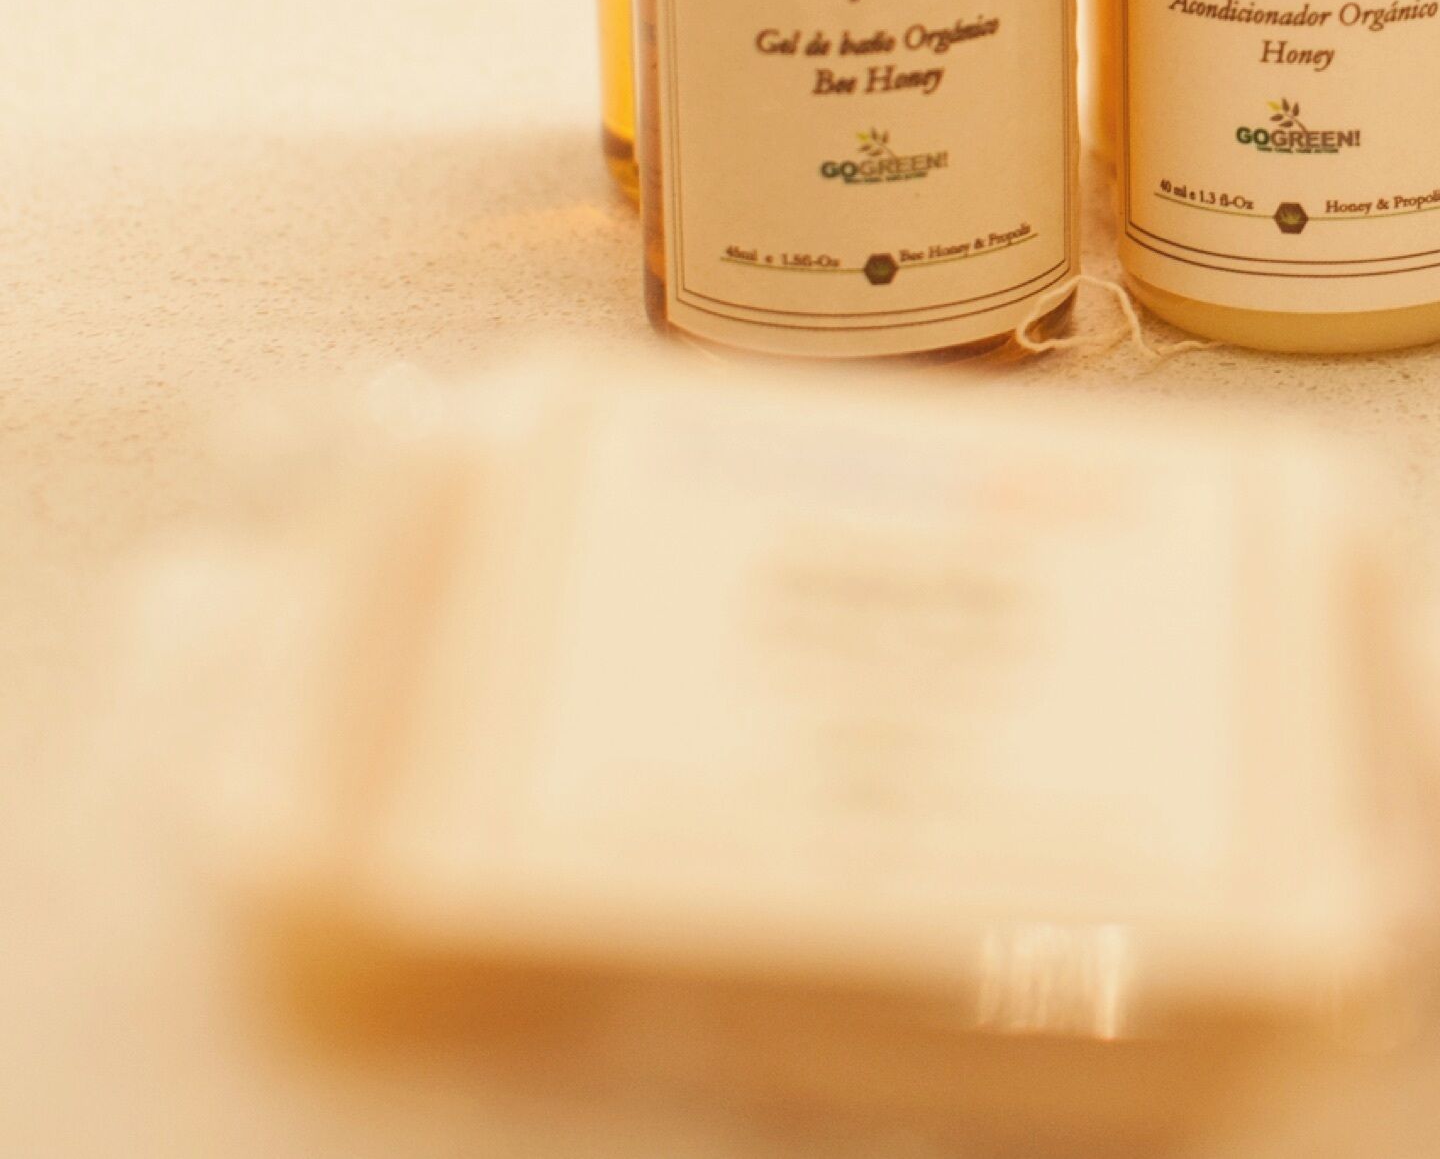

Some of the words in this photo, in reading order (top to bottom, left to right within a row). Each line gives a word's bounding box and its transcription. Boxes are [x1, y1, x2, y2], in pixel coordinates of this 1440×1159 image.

[755, 28, 801, 56] Gel
[804, 30, 831, 56] de
[1259, 39, 1335, 73] Honey
[812, 67, 857, 95] Bee
[865, 64, 946, 95] Honey
[1236, 126, 1361, 148] GOGREEN!
[1200, 189, 1216, 205] 1.3
[1326, 199, 1372, 215] Honey
[1376, 197, 1390, 210] &
[928, 243, 970, 259] Honey
[974, 237, 985, 250] &
